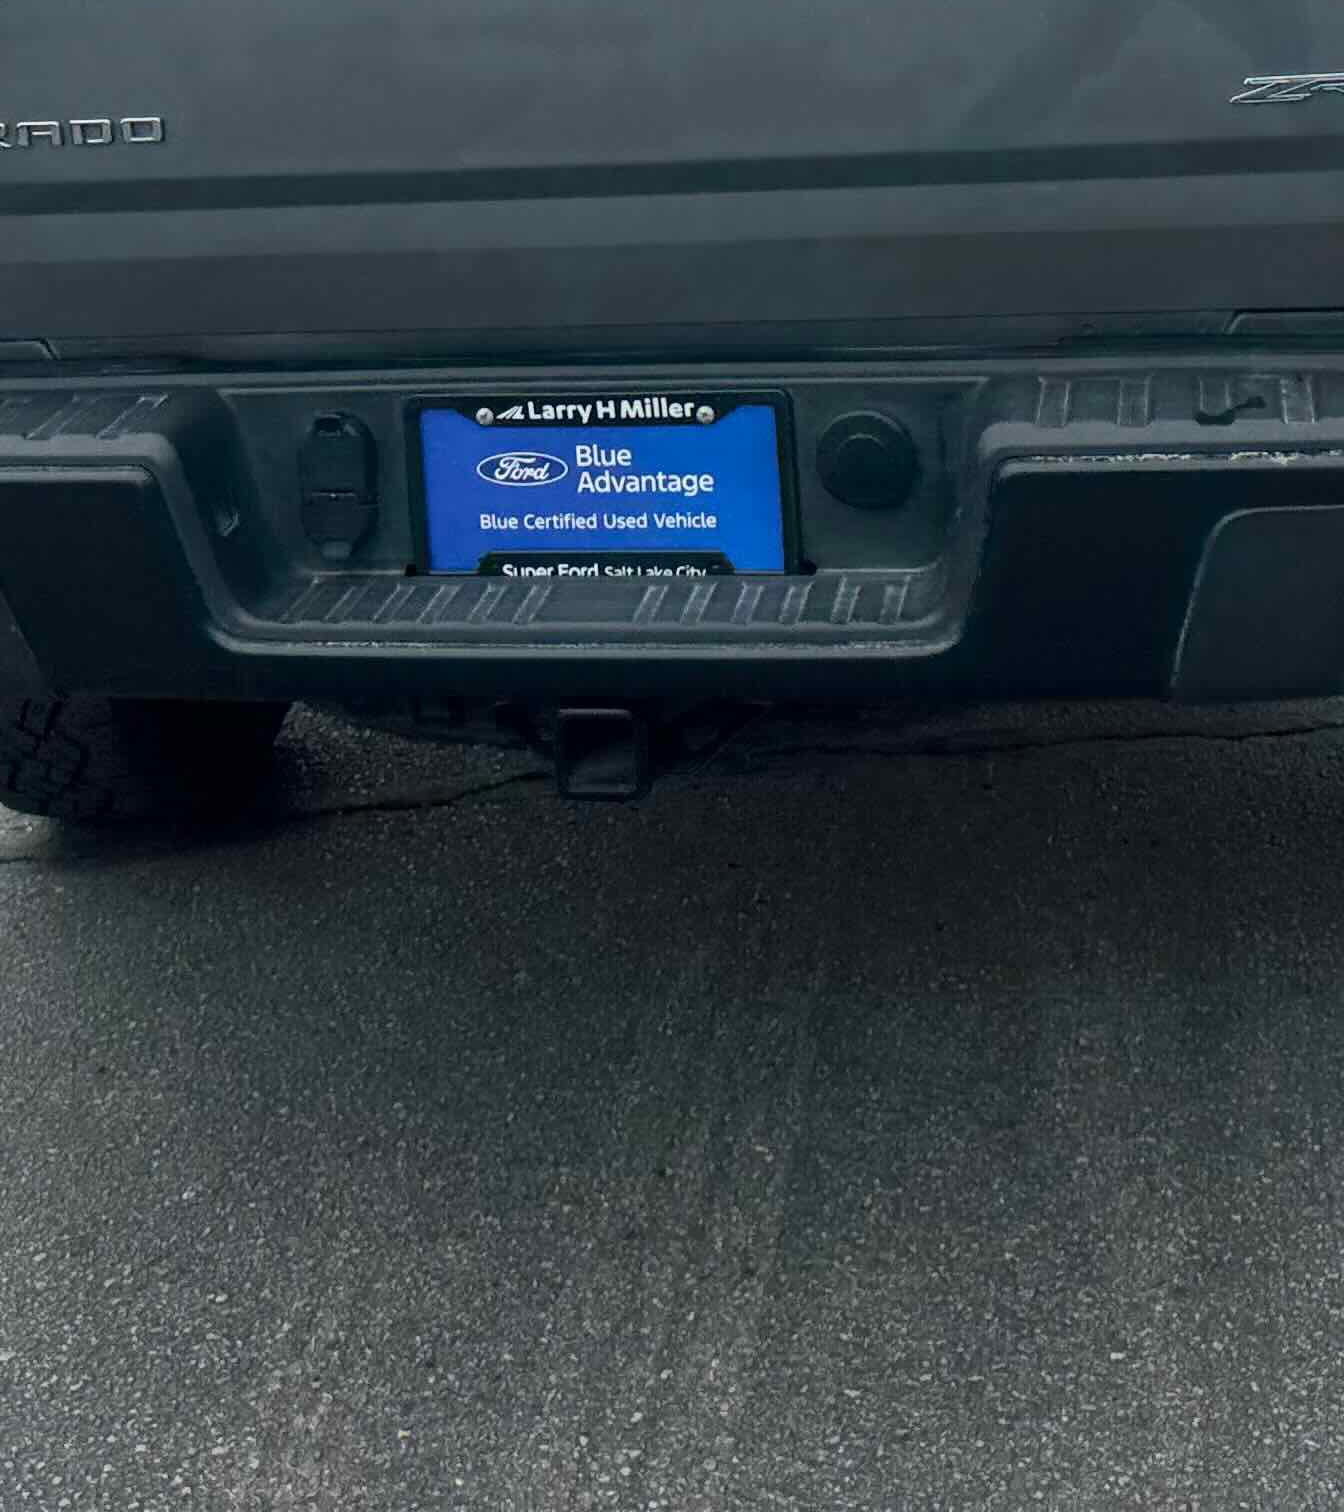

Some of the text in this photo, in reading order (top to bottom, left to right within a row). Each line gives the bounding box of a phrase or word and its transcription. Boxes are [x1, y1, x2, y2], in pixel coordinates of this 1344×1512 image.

[527, 397, 695, 424] Larry H Miller
[576, 444, 632, 467] Blue
[493, 455, 551, 482] Ford
[577, 470, 715, 497] Advantage
[479, 512, 717, 530] Blue Certified Used Vehicle
[558, 563, 599, 577] Ford
